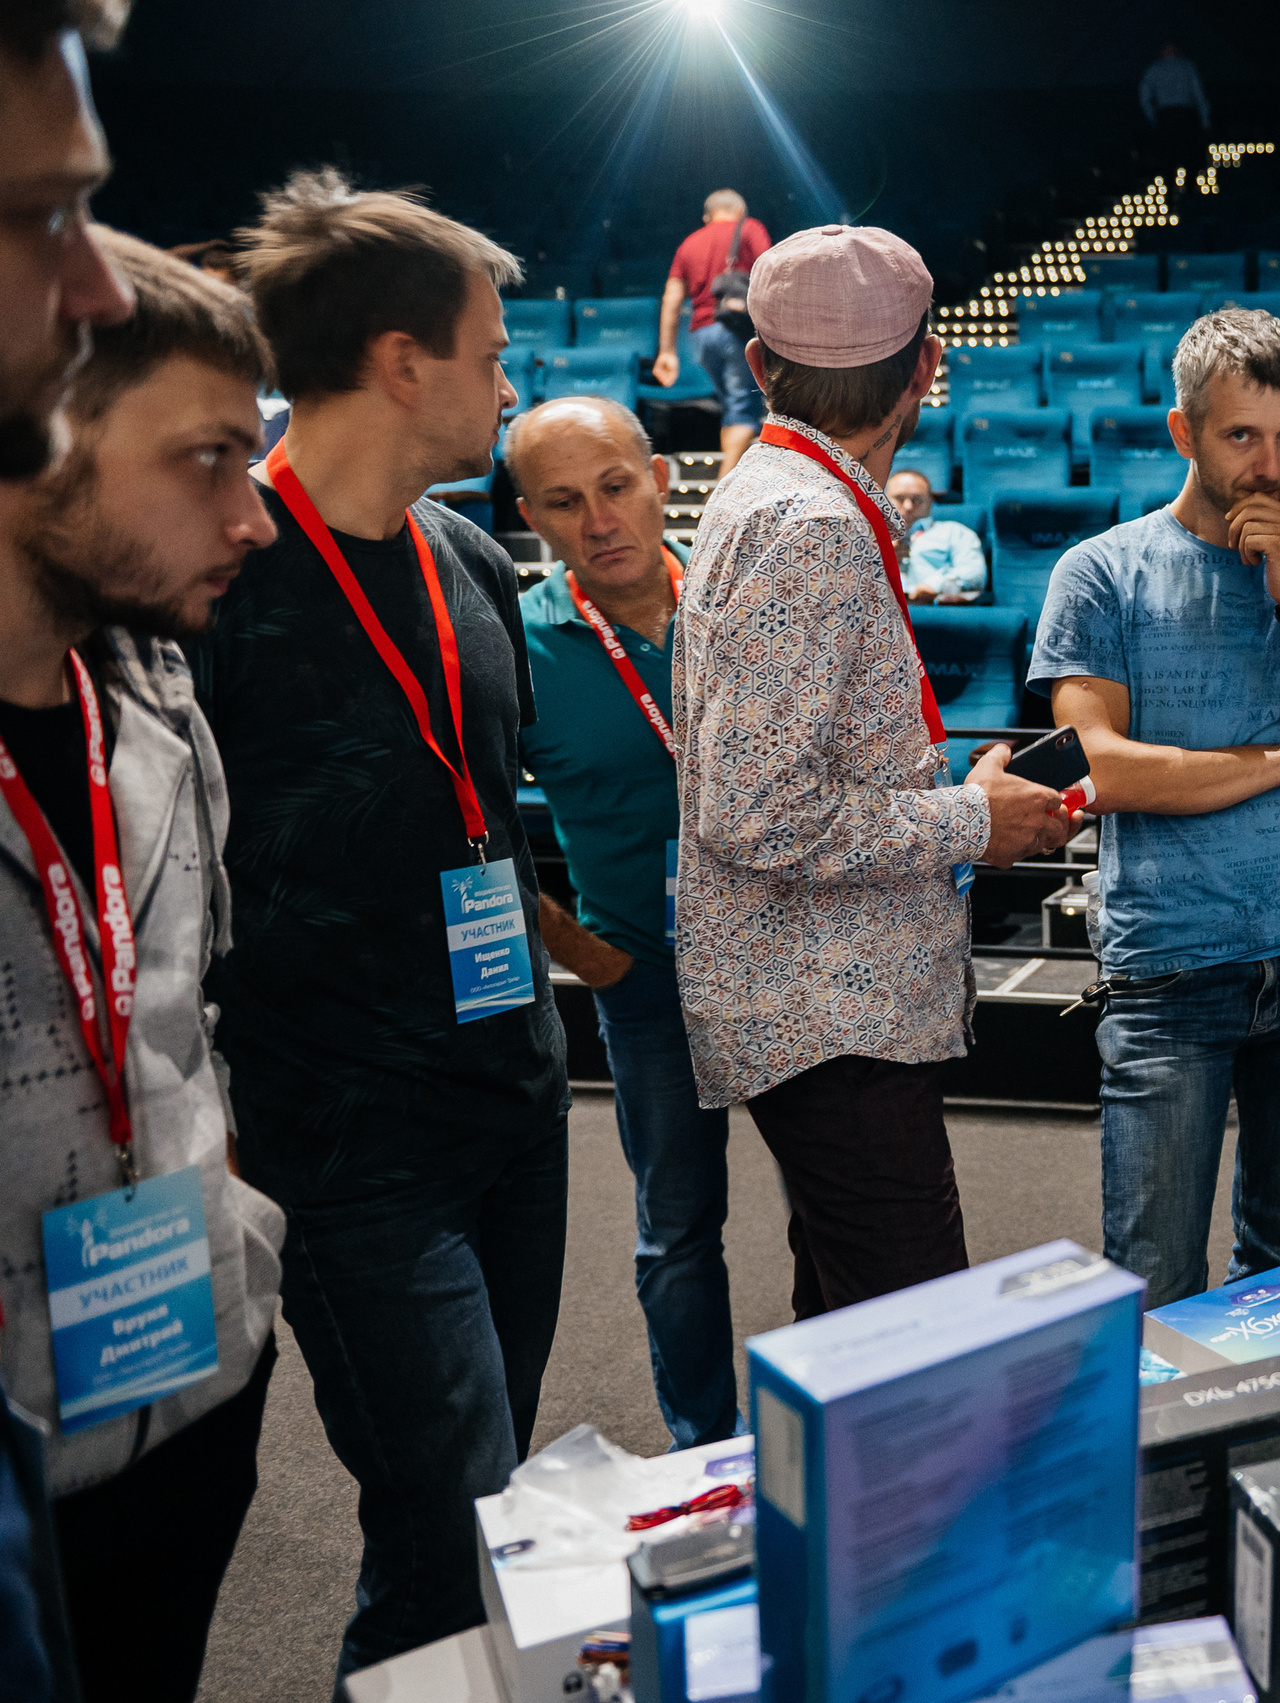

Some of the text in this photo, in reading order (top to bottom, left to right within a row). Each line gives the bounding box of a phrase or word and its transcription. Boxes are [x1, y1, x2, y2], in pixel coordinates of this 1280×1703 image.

[581, 600, 624, 650] Pandora
[1223, 859, 1248, 869] GOOD
[464, 892, 514, 914] Pandora
[48, 863, 93, 998] Pandora
[102, 863, 137, 992] Pandora
[461, 918, 516, 942] УЧАСТНИК
[474, 947, 511, 963] Ищенко
[90, 1217, 190, 1267] Pandora
[79, 1256, 189, 1310] УЧАСТНИК
[1183, 1385, 1235, 1408] DXL
